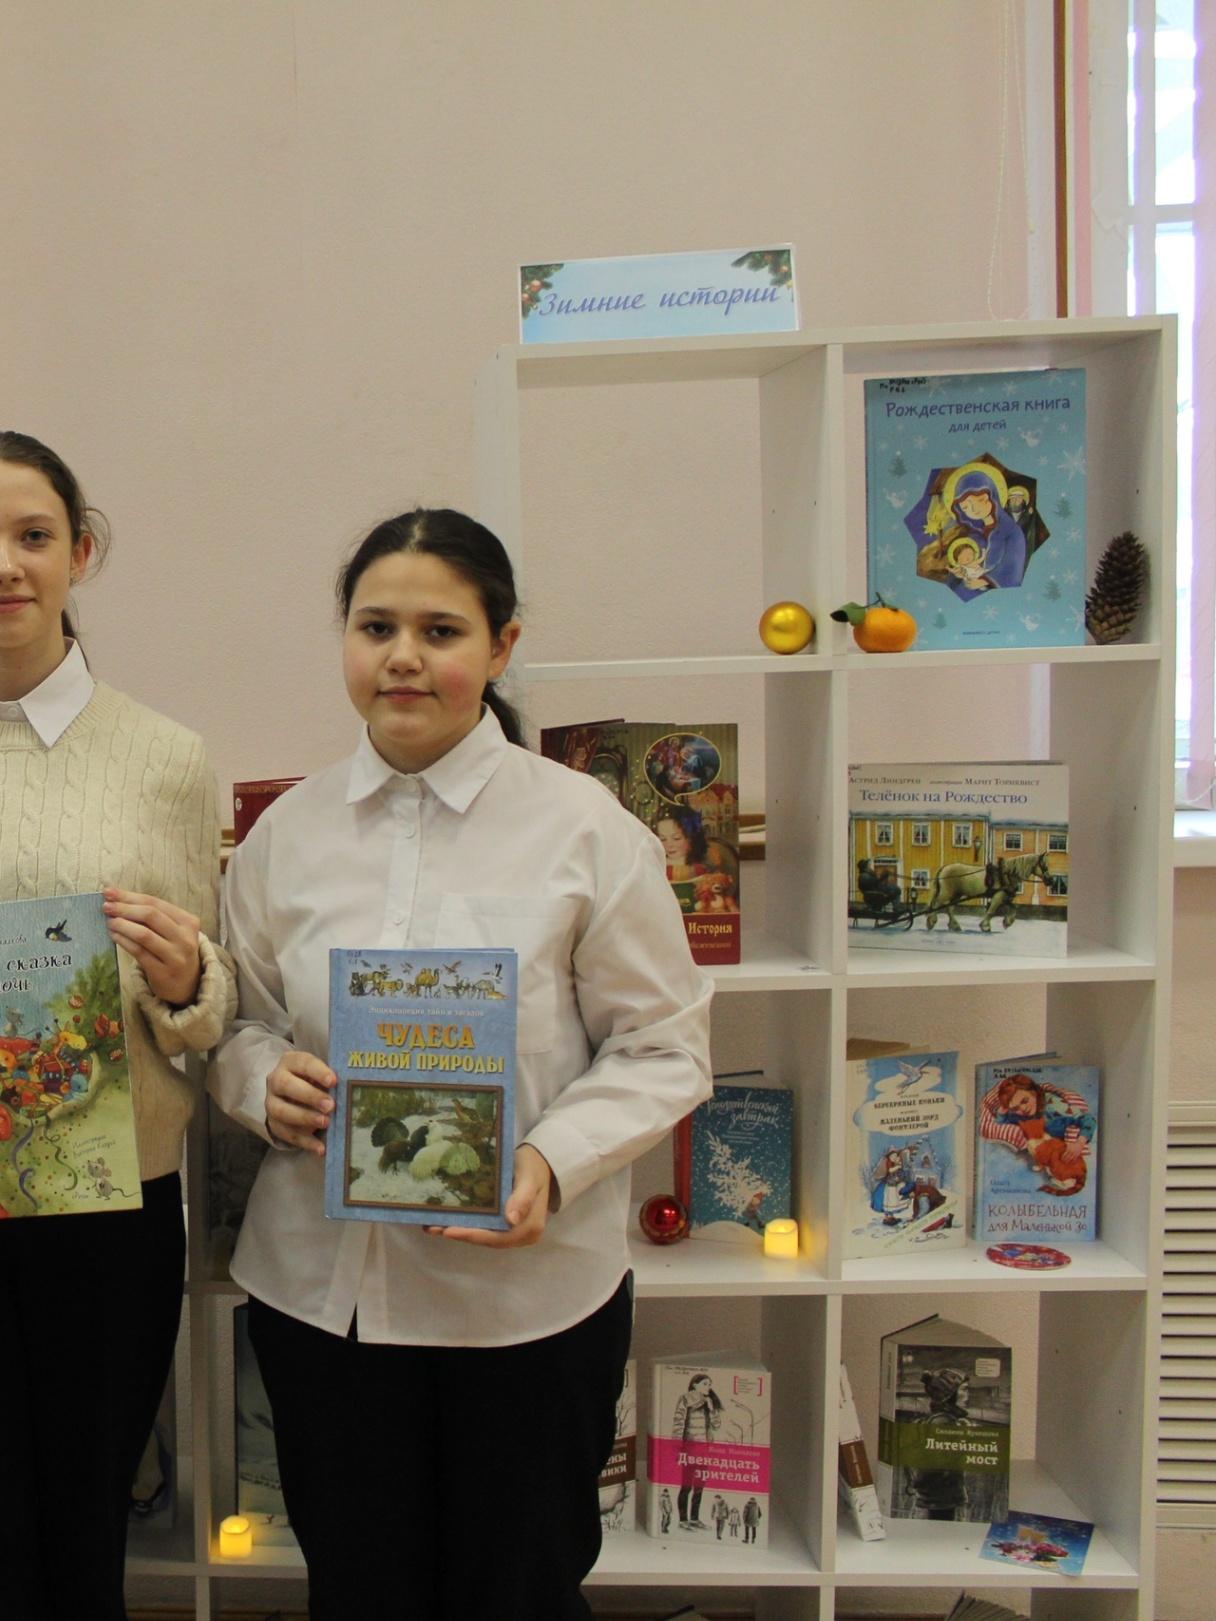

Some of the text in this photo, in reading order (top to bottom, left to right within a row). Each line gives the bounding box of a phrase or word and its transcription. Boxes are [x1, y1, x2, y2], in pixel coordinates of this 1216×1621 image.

[538, 285, 781, 316] Зимние истории
[885, 397, 1072, 418] Рождественская книга
[948, 419, 1007, 434] для детей
[858, 788, 1029, 805] Телёнок на Рождество
[687, 922, 733, 937] История
[6, 953, 74, 972] сказка
[376, 1022, 477, 1050] ЧУДЕСА
[347, 1049, 506, 1075] ЖИВОЙ ПРИРОДЫ
[987, 1203, 1088, 1219] КОЛЫБЕЛЬНАЯ
[987, 1219, 1088, 1234] для Маленькой Зо
[925, 1436, 999, 1454] Литейный
[677, 1451, 761, 1471] Двенадцать
[965, 1455, 999, 1466] мост
[694, 1466, 760, 1485] зрителей
